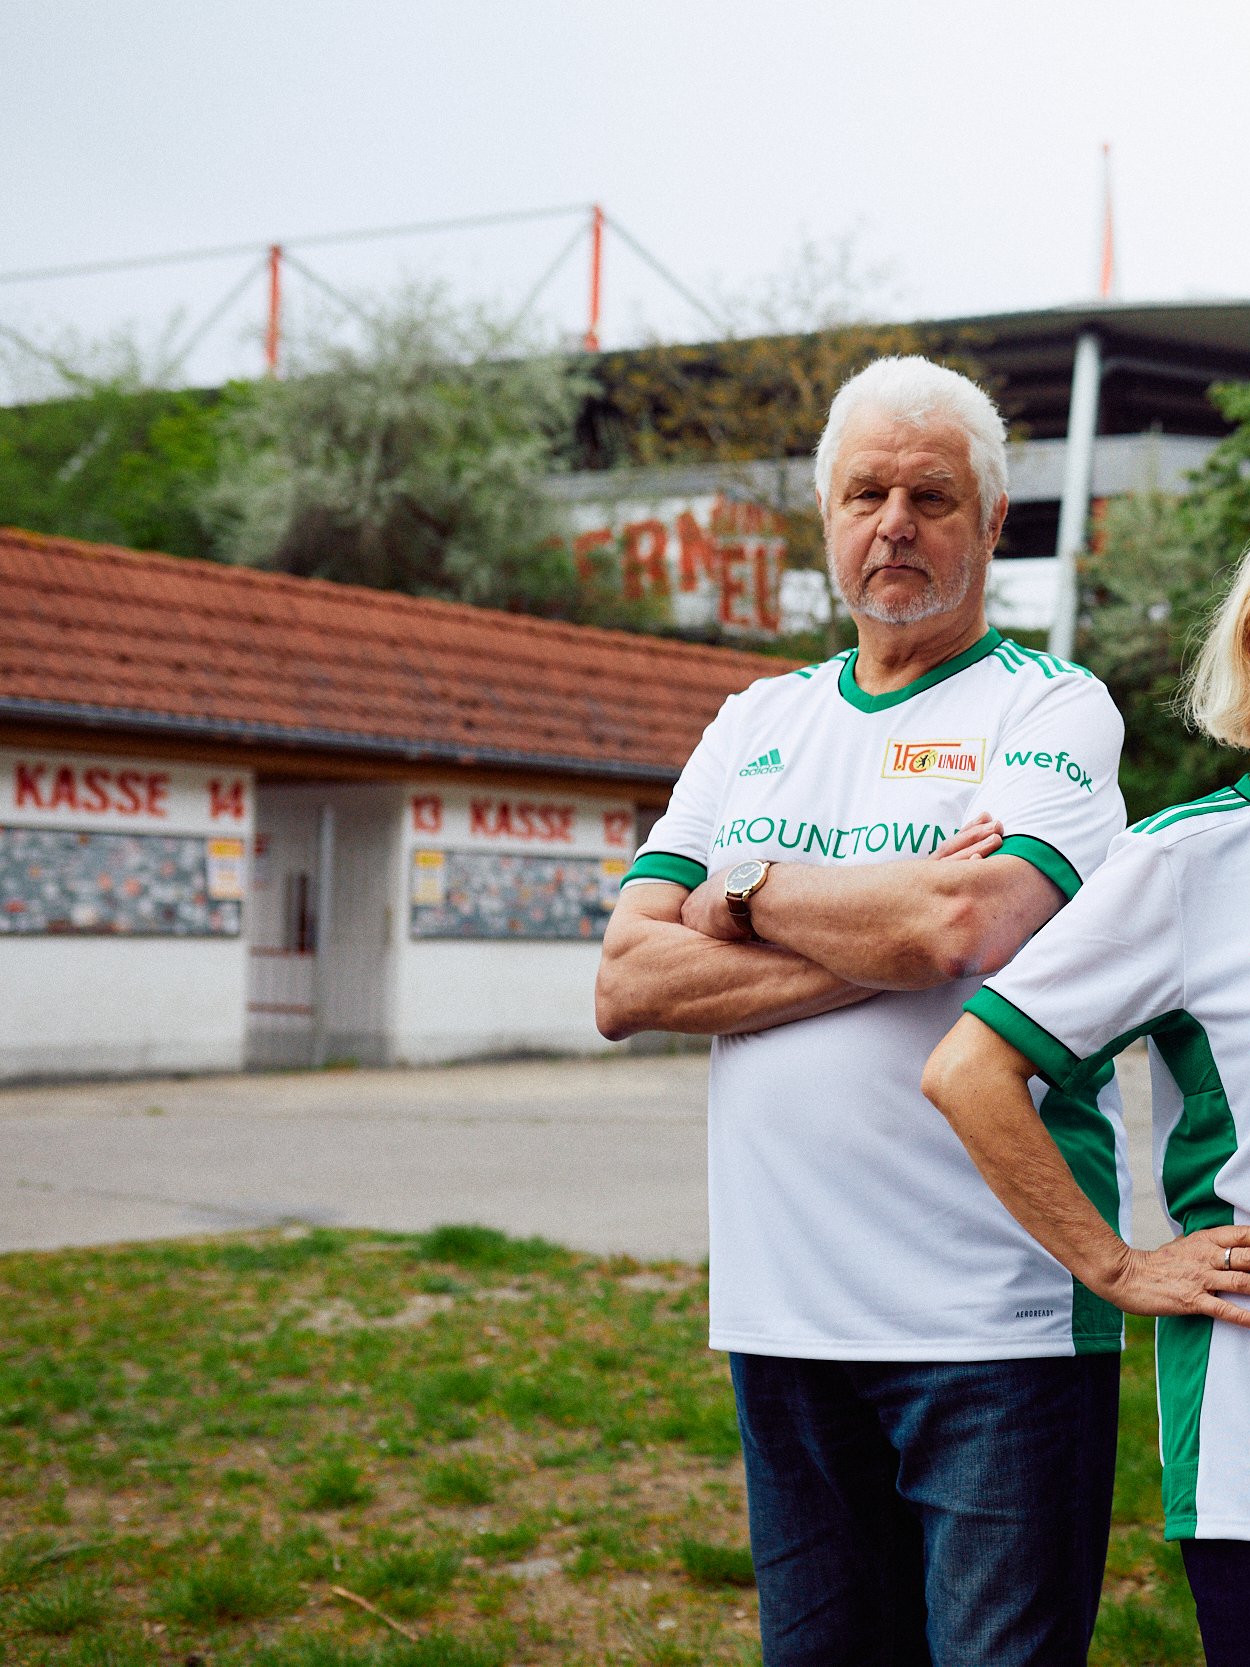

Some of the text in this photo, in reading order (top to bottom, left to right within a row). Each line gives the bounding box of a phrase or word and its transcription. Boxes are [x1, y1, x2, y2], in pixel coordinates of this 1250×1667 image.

[739, 763, 784, 777] adidas
[937, 753, 977, 772] UNION
[1004, 751, 1093, 794] wefox
[14, 761, 247, 823] KASSE 14
[469, 798, 577, 844] KASSE
[1015, 1309, 1054, 1319] AEROREADY
